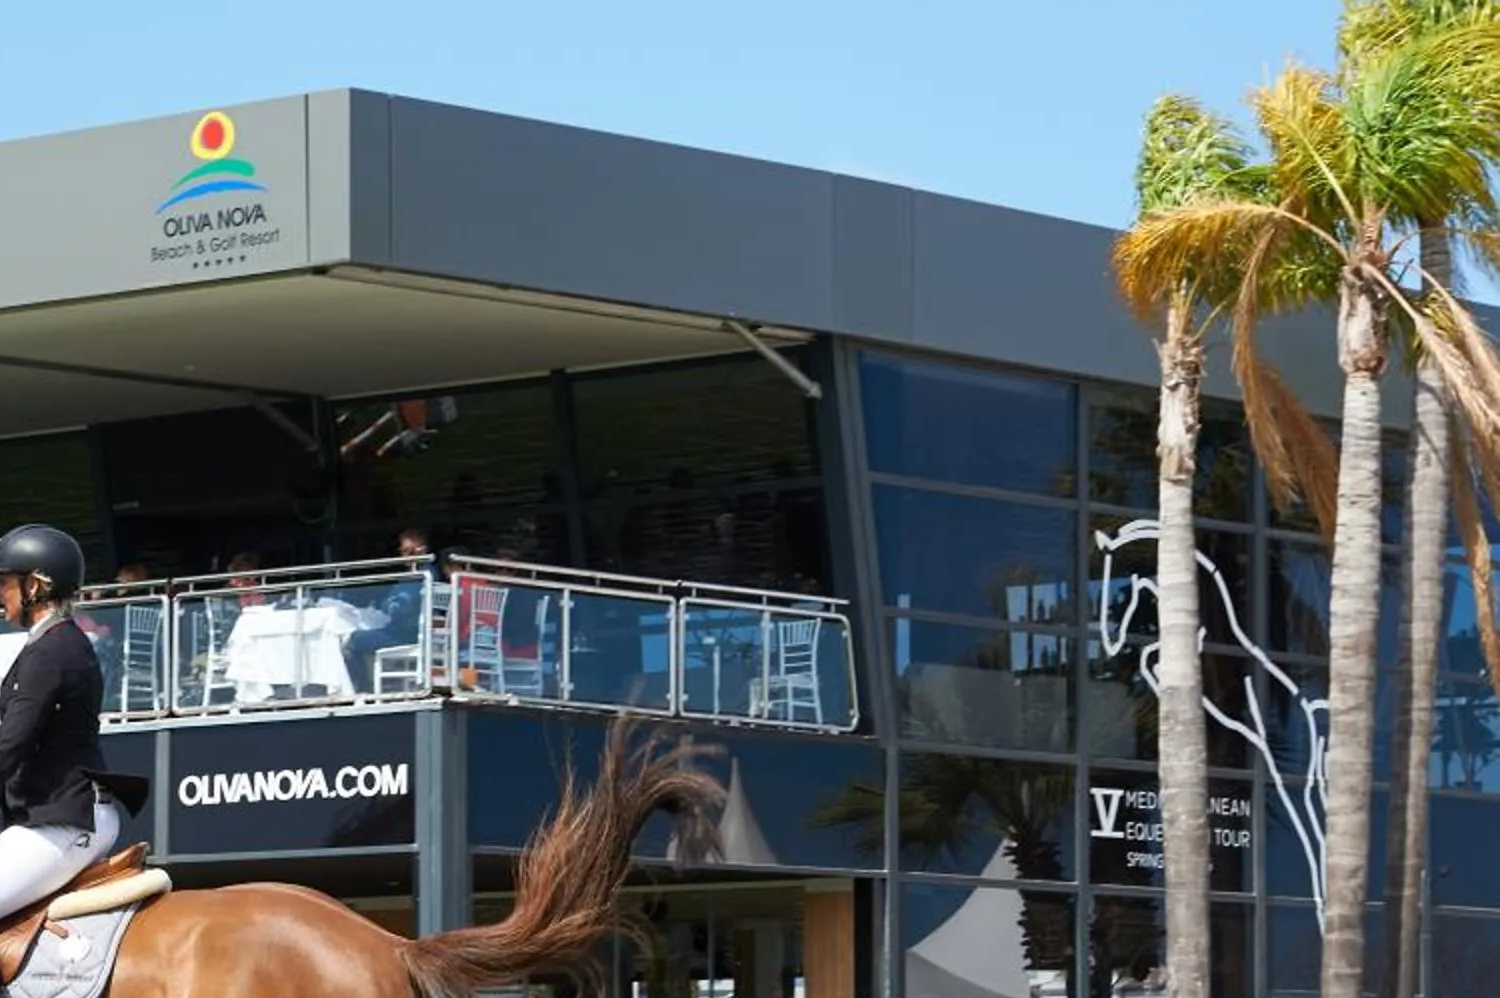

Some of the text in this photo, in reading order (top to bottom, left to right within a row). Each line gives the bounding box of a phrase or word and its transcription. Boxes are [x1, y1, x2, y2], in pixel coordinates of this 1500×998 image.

[163, 204, 267, 237] OLIVA NOVA
[151, 228, 280, 263] Beach & Golf Resort
[178, 763, 409, 807] OLIVANOVA.COM
[1215, 828, 1251, 847] TOUR
